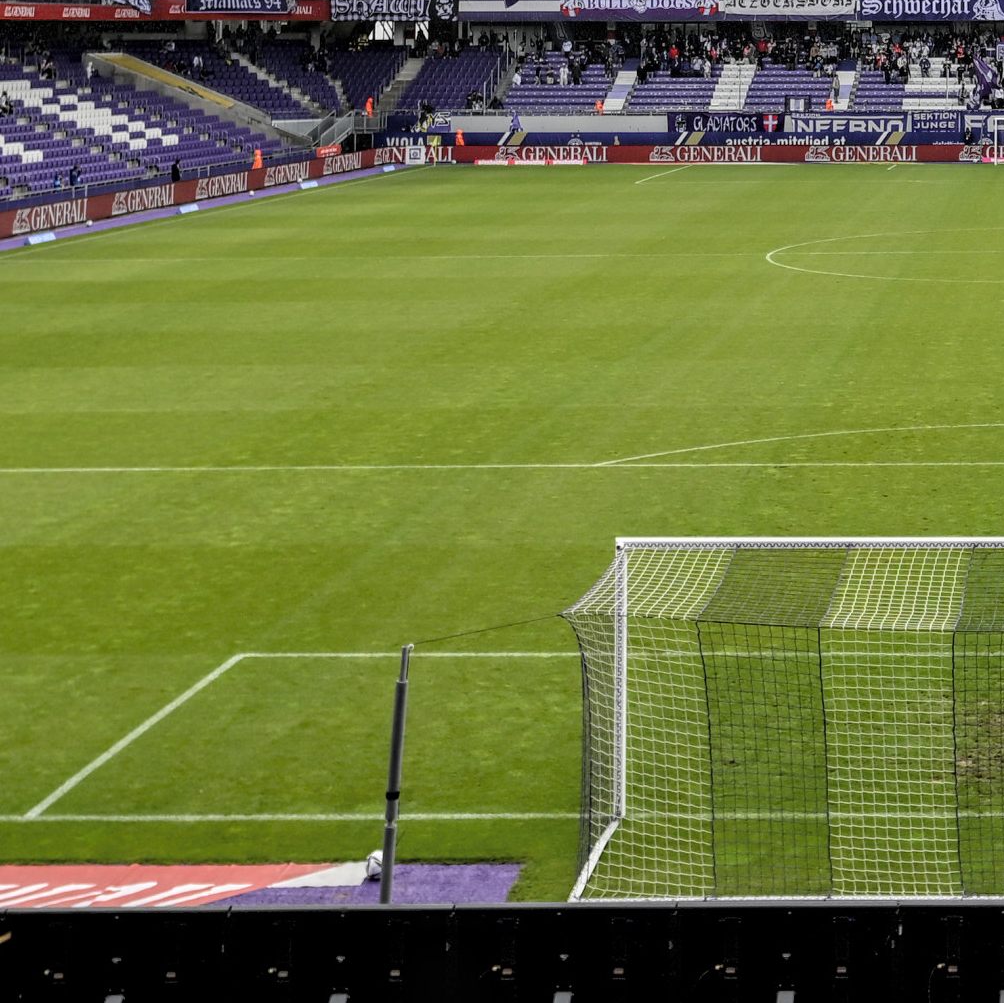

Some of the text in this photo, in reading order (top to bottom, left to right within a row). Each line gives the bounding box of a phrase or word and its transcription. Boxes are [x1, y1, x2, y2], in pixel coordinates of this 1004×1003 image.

[693, 115, 757, 132] GLADIATORS
[913, 112, 958, 121] SEKTION
[791, 119, 904, 132] INFERNO
[913, 121, 956, 130] JUNGE
[383, 146, 454, 164] GENALI
[521, 146, 609, 162] GENERALI
[676, 146, 763, 162] GENERALI
[831, 146, 918, 162] GENERALI
[332, 152, 362, 174] GENERALI
[275, 160, 310, 185] GENERALI
[208, 171, 249, 197] GENERALI
[128, 183, 176, 212] GENERALI
[31, 198, 89, 230] GENERALI
